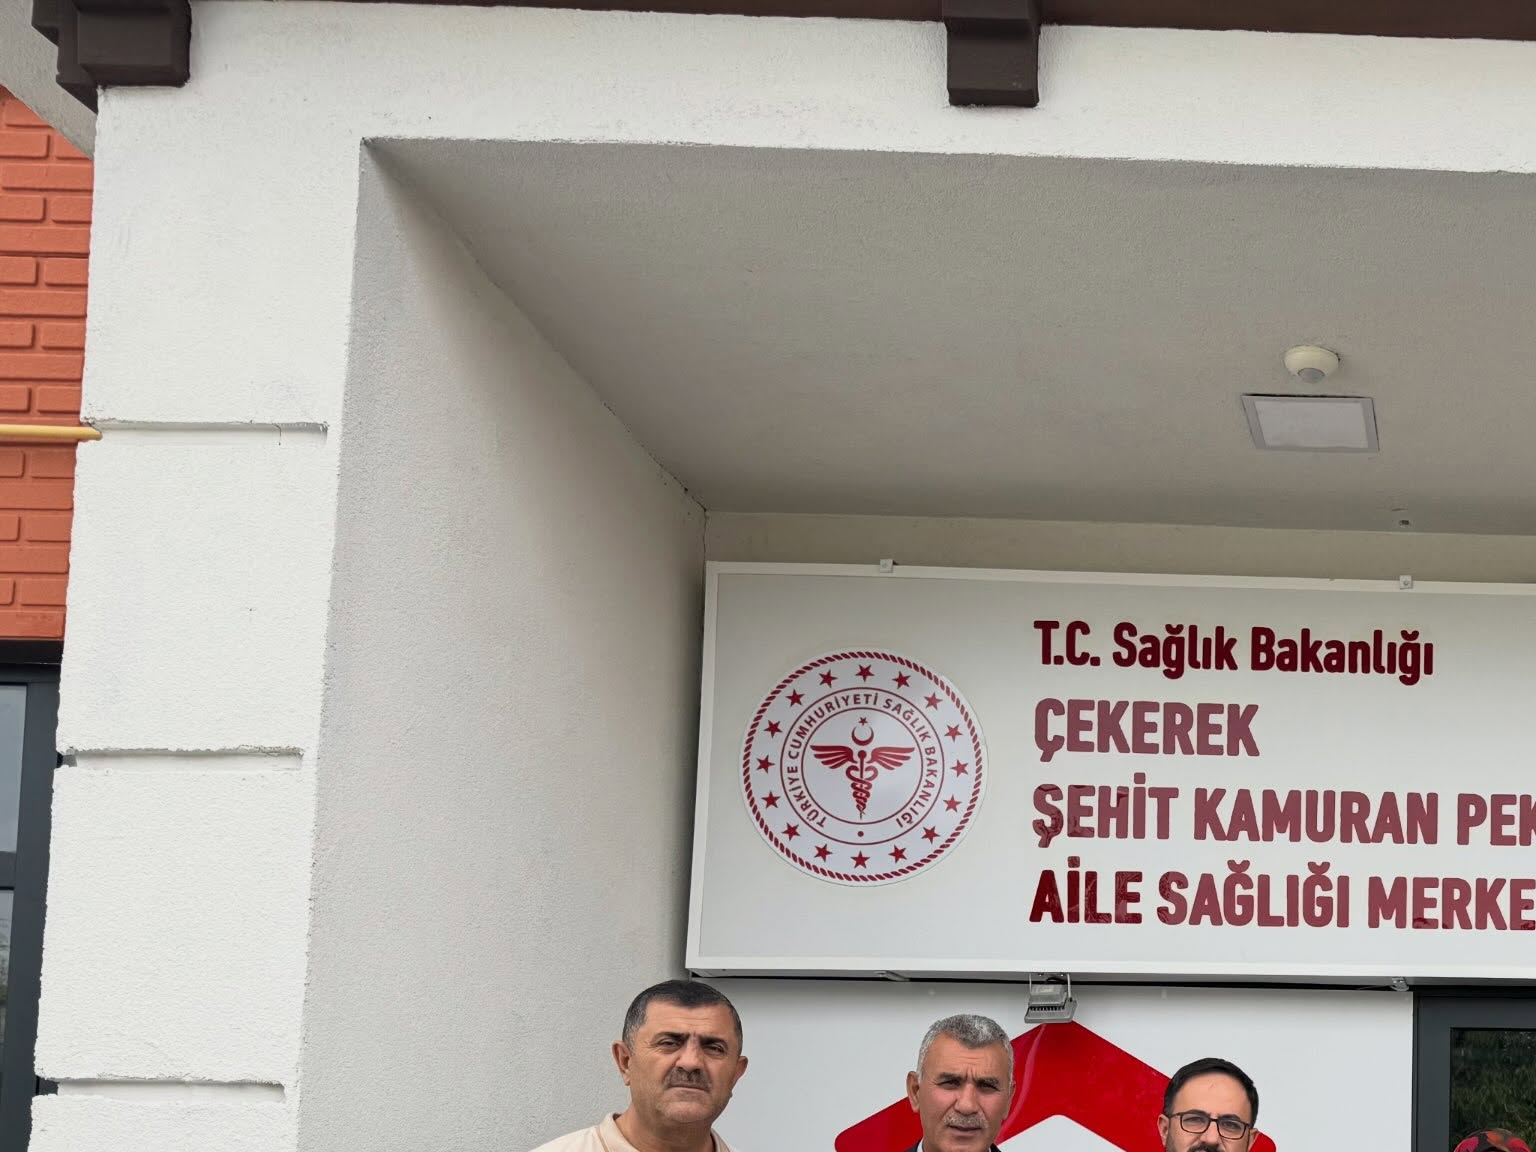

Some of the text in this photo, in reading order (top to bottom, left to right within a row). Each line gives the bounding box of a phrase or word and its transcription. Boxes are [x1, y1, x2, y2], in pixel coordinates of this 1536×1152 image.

[1034, 620, 1434, 686] T.C. Sağlık Bakanlığı
[787, 692, 938, 829] TÜRKİYE CUMHURİYETİ SAĞLIK BAKANLIĞI
[1035, 699, 1259, 762] ÇEKEREK
[1032, 773, 1179, 849] ŞEHİT
[1194, 788, 1439, 845] KAMURAN
[1029, 856, 1144, 925] AİLE
[1156, 860, 1350, 929] SAĞLIĞI
